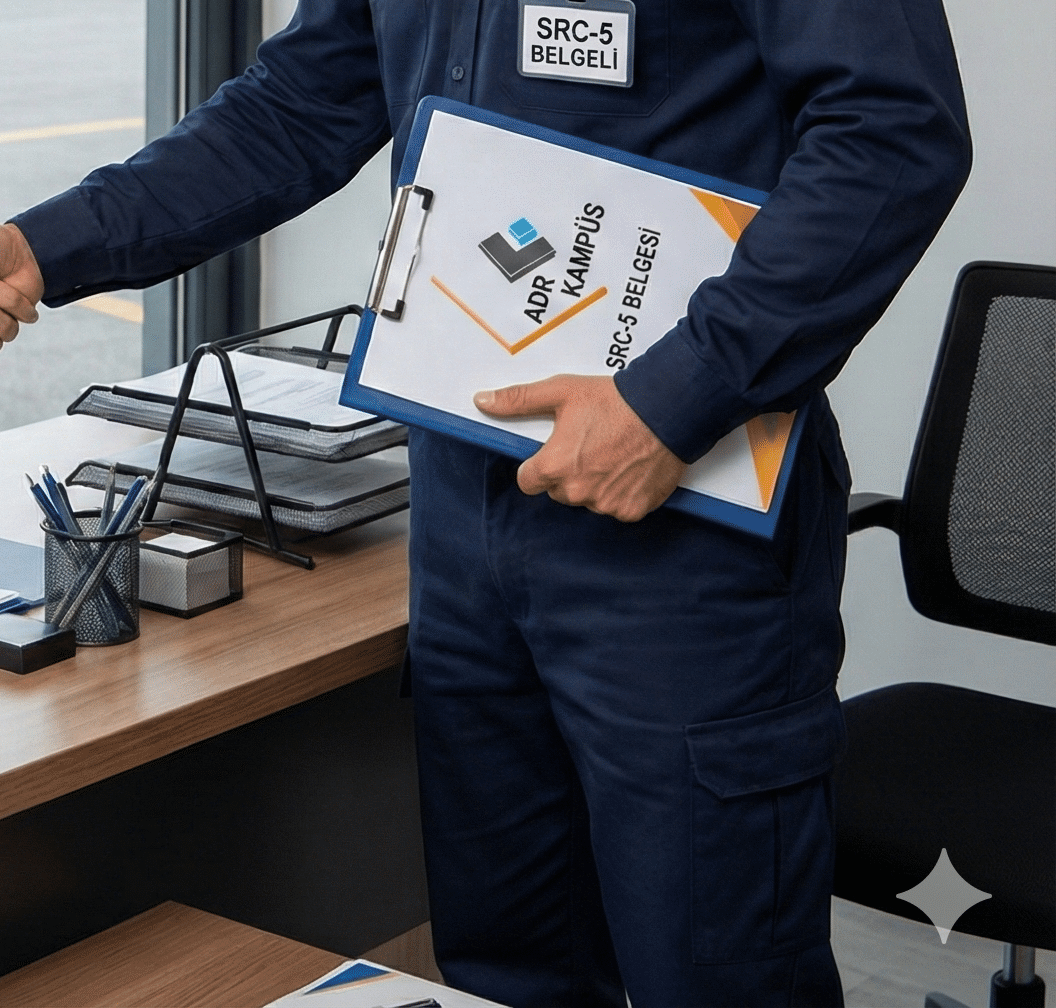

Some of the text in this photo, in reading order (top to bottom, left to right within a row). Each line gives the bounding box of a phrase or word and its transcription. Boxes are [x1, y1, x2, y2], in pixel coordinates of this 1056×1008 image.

[537, 17, 613, 45] SRC-5
[531, 45, 618, 70] BELGELİ
[561, 203, 604, 297] KAMPÜS
[523, 275, 556, 325] ADR
[605, 227, 661, 369] SRC-5 BELGESİ
